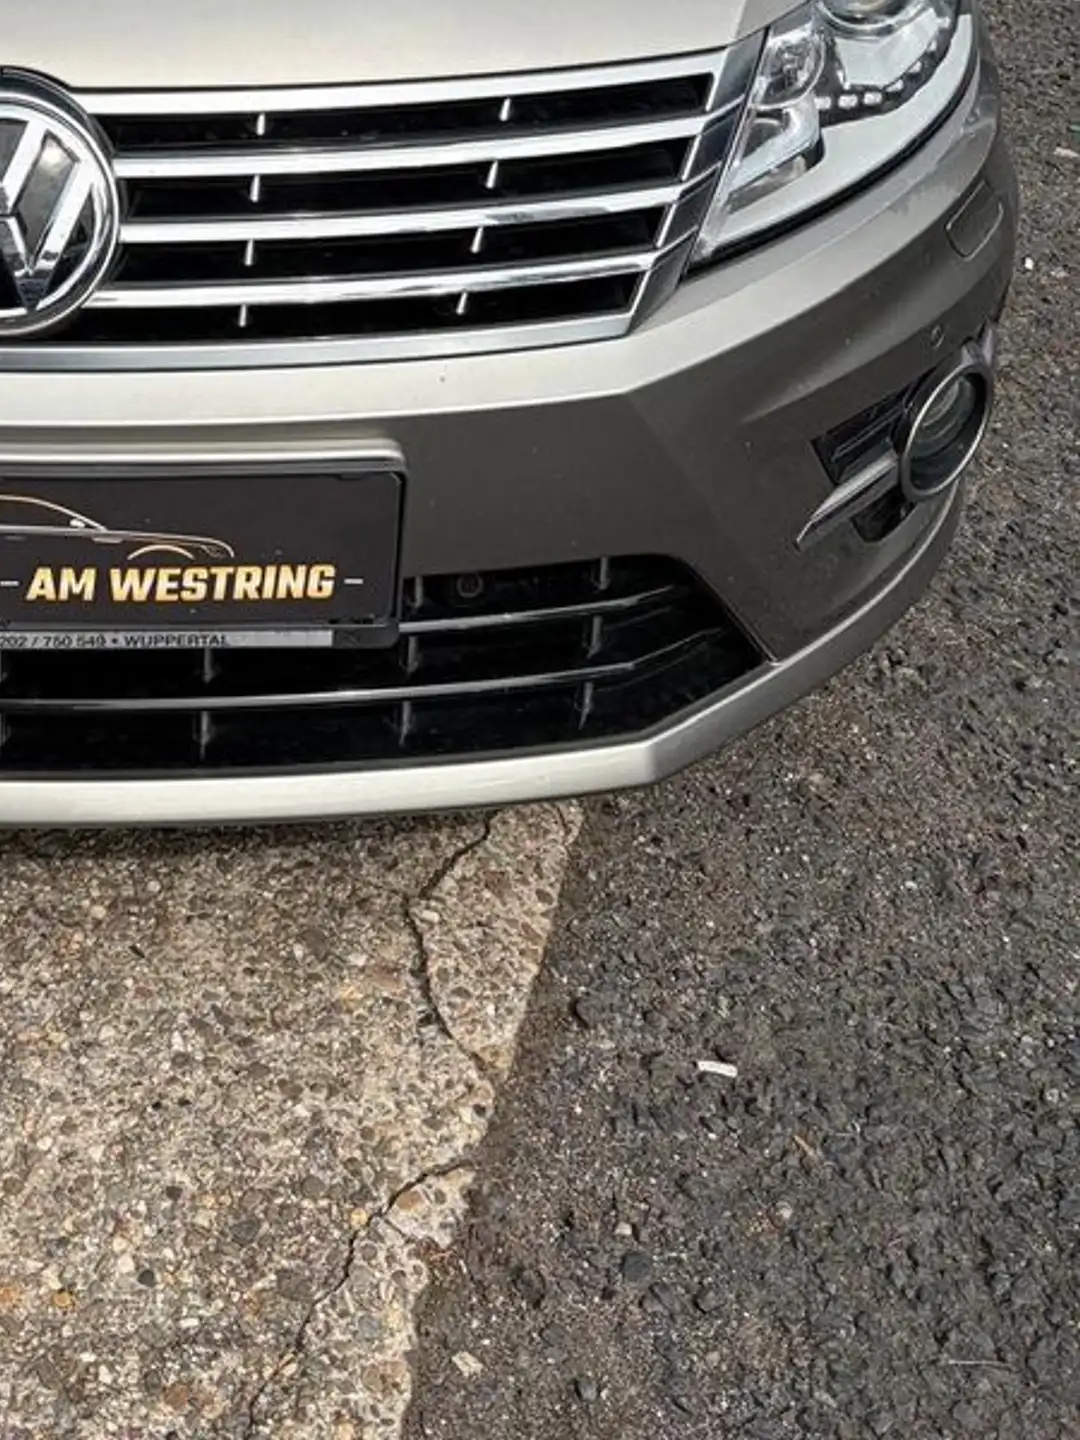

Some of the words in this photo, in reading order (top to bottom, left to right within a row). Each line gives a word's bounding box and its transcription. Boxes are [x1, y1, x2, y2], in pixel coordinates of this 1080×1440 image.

[26, 566, 98, 602] AM
[109, 563, 337, 602] WESTRING
[124, 633, 229, 648] WUPPERTAL
